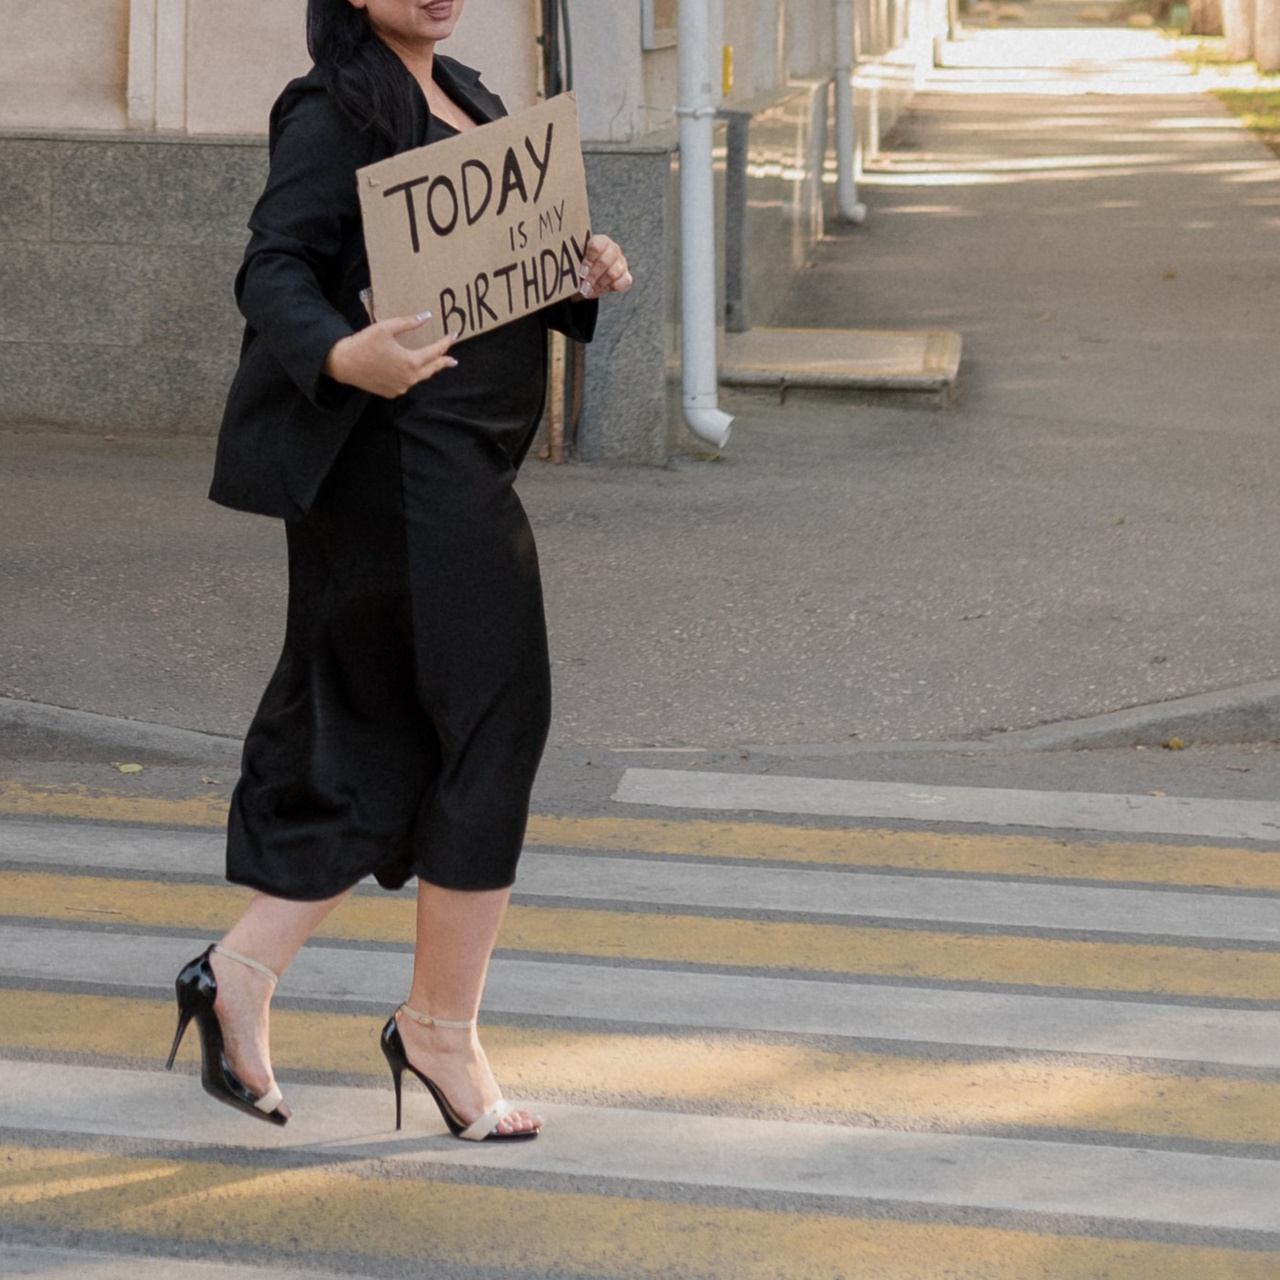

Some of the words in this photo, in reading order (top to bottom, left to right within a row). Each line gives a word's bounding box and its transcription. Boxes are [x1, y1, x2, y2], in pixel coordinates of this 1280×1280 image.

[383, 122, 553, 253] TODAY
[509, 221, 528, 251] IS
[539, 199, 565, 240] MY
[439, 229, 591, 338] BIRTHDAY
